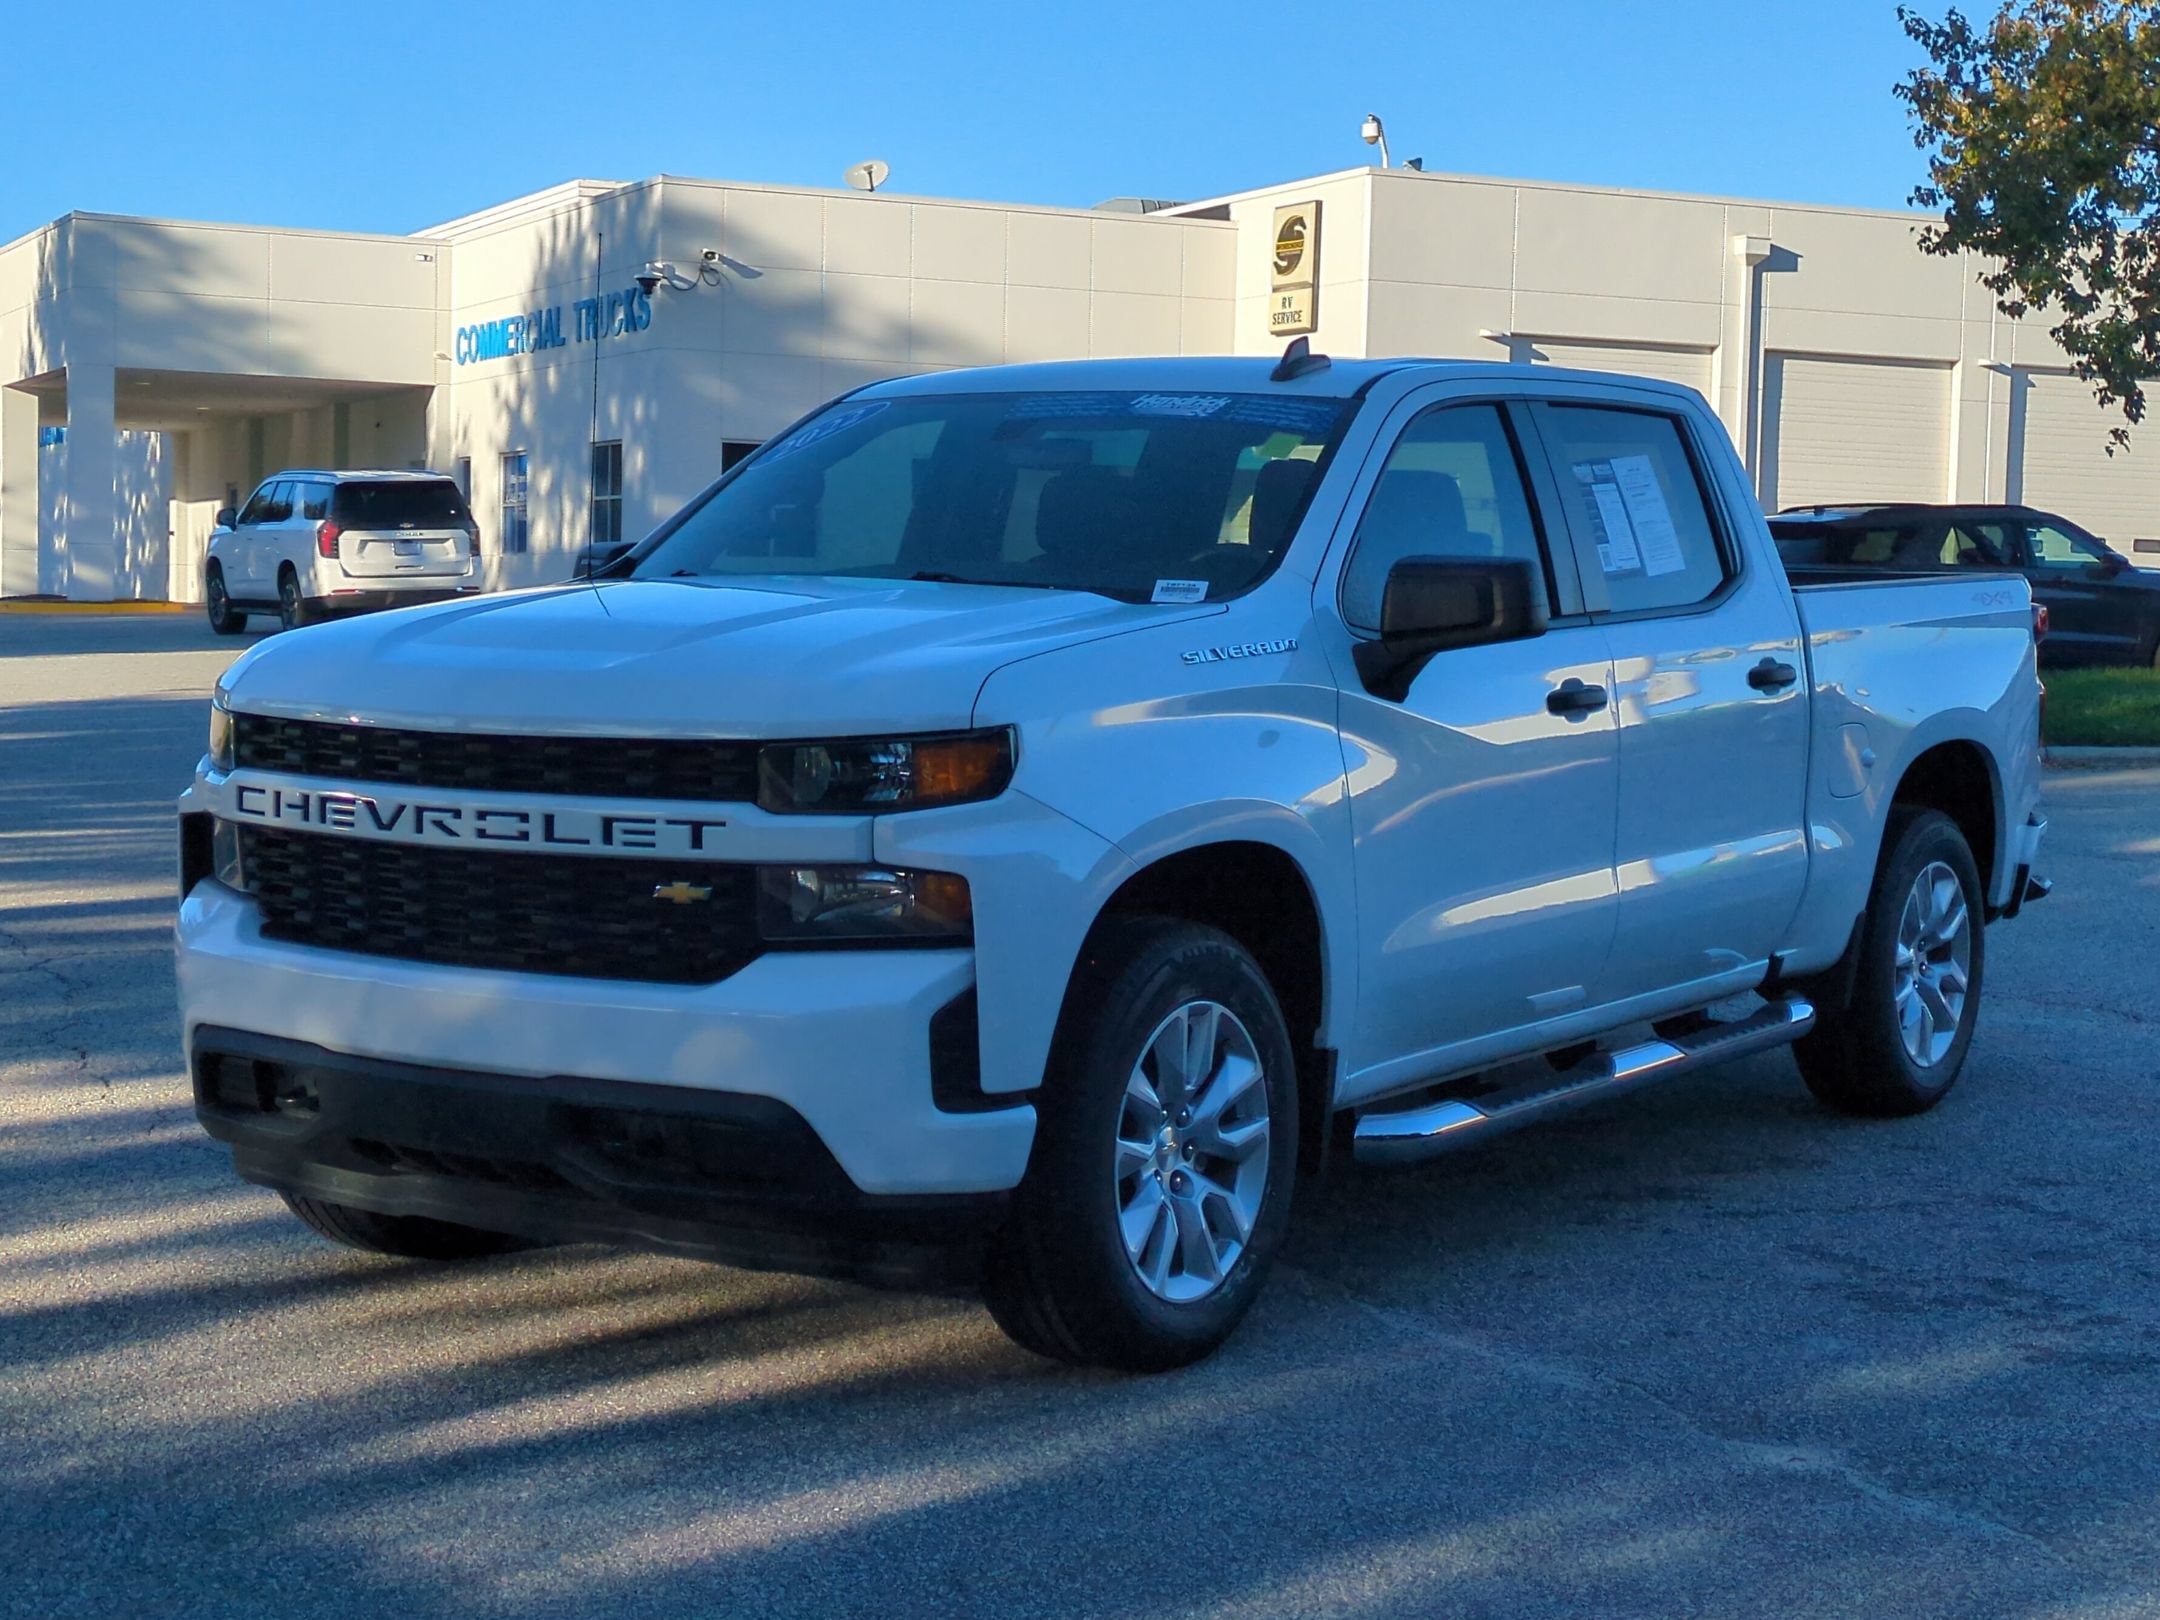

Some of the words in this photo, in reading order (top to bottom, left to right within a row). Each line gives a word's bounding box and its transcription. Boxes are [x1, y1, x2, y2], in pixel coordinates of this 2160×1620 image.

[1281, 296, 1293, 309] RV
[455, 306, 566, 366] COMMERCIAL
[572, 288, 652, 343] TRUCKS
[1272, 309, 1303, 325] SERVICE
[1181, 638, 1298, 665] SILVERADO
[236, 785, 727, 851] CHEVROLET
